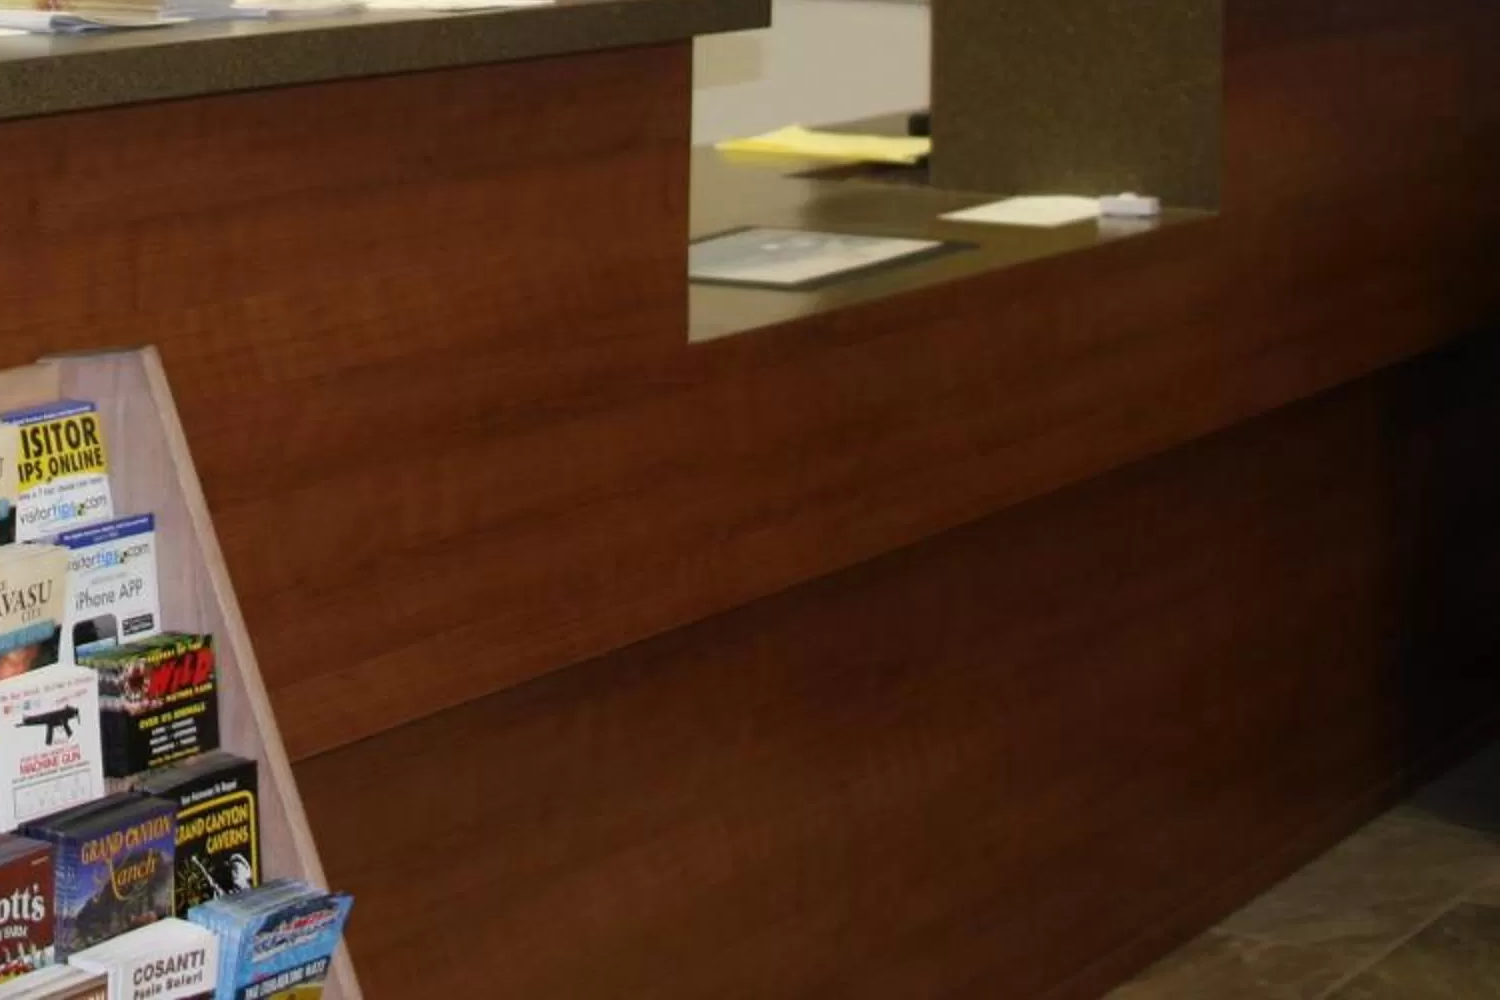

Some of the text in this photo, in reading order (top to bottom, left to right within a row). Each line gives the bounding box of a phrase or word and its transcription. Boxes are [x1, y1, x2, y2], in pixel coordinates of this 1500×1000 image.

[20, 416, 99, 459] ISITOR
[17, 448, 105, 483] IPS ONLINE
[75, 579, 144, 611] iPhone APP
[146, 647, 214, 697] WILD
[61, 750, 81, 766] GUN
[205, 804, 248, 834] CANYON
[81, 815, 171, 865] GRAND CANYON
[206, 826, 249, 855] CAVERNS
[133, 948, 205, 986] COSANTI
